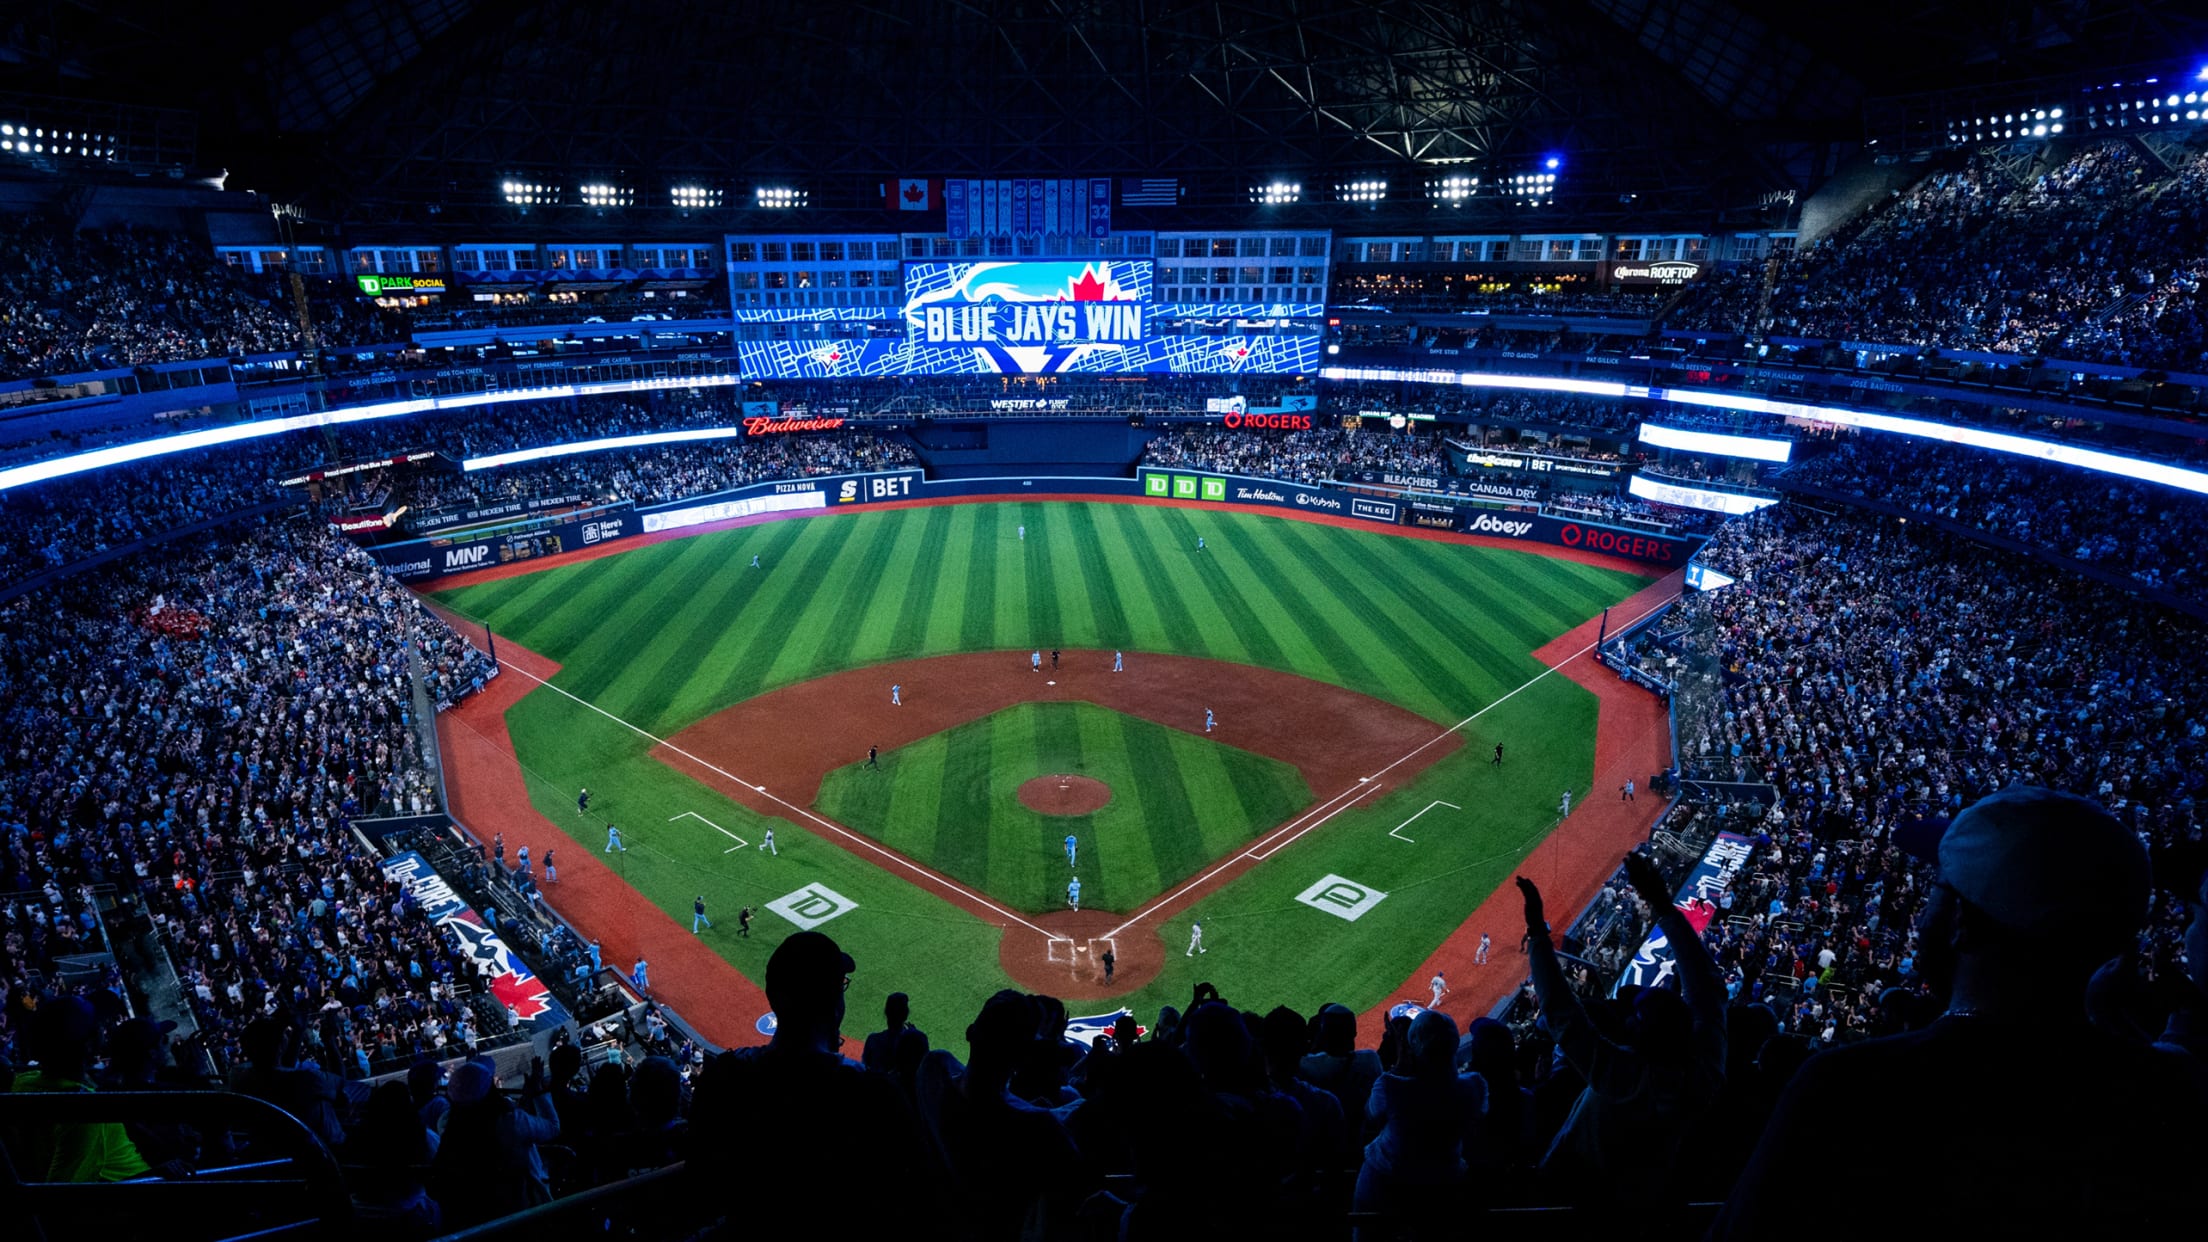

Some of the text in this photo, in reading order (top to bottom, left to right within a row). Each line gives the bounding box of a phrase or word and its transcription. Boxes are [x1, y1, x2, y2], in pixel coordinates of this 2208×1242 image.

[1091, 204, 1109, 220] 32
[1614, 266, 1698, 280] Corona ROOFTOP
[360, 276, 446, 293] TD PARK SOCIAL
[926, 304, 1142, 342] BLUE JAYS WIN
[990, 399, 1036, 410] WESTJET
[742, 415, 844, 436] Budweiser
[1244, 414, 1312, 430] ROGERS
[1532, 460, 1553, 472] BET
[776, 483, 816, 493] PIZZA NOVA
[873, 477, 912, 497] BET
[1147, 477, 1167, 493] TD
[1175, 480, 1195, 495] TD
[1383, 474, 1438, 489] BLEACHERS
[1204, 482, 1223, 497] TD
[1236, 487, 1285, 503] Tim Hortons
[1469, 482, 1538, 499] CANADA DRY
[540, 497, 566, 508] NEXEN
[566, 494, 582, 505] TIRE
[1309, 495, 1341, 509] Kubota
[480, 506, 505, 517] NEXEN
[505, 503, 522, 513] TIRE
[1357, 504, 1391, 516] THE KEG
[340, 519, 383, 532] BeautiTone
[442, 513, 459, 524] TIRE
[600, 518, 623, 530] Here's
[1469, 513, 1534, 537] Sobeys
[601, 527, 621, 539] How.
[1584, 528, 1672, 561] ROGERS
[445, 545, 489, 568] MNP
[485, 666, 499, 681] VISA
[412, 874, 461, 910] CORE
[1311, 876, 1368, 906] TD
[787, 888, 840, 921] TD
